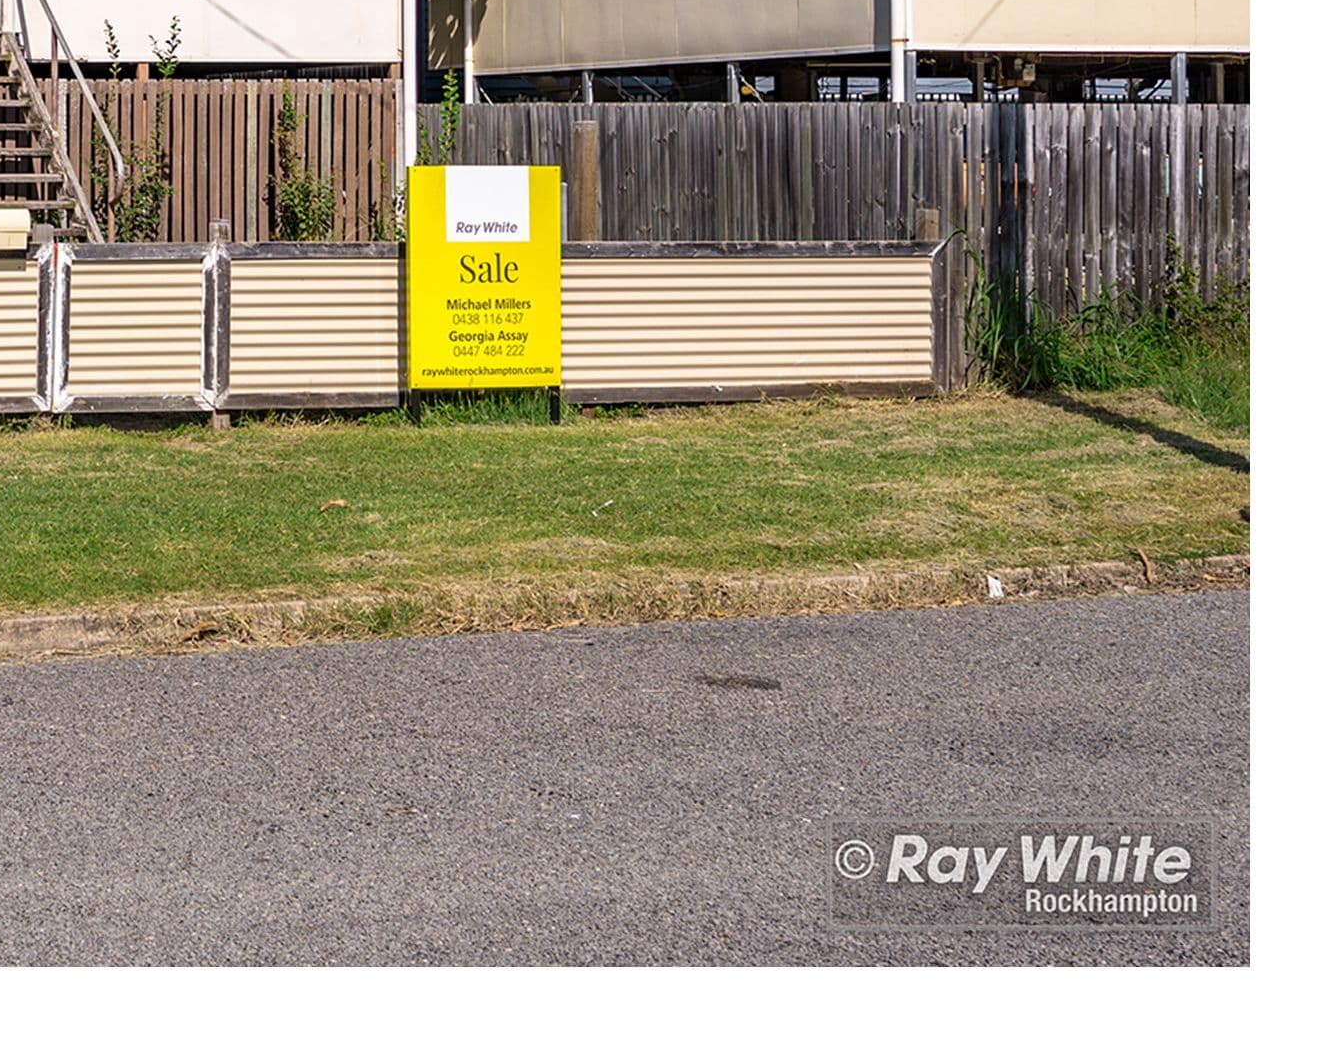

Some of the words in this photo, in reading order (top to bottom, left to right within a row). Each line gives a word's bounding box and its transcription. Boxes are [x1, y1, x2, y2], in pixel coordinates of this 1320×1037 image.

[456, 221, 481, 235] Ray
[483, 221, 518, 233] White
[460, 253, 519, 284] Sale
[447, 299, 492, 310] Michael
[495, 299, 531, 310] Millers
[453, 314, 480, 325] 0438
[484, 314, 502, 325] 116
[505, 314, 523, 324] 437
[449, 331, 495, 344] Georgia
[498, 330, 528, 343] Assay
[453, 346, 480, 357] 0447
[483, 346, 503, 356] 484
[506, 345, 524, 356] 222
[422, 366, 554, 377] raywhiterockhampton.com.au
